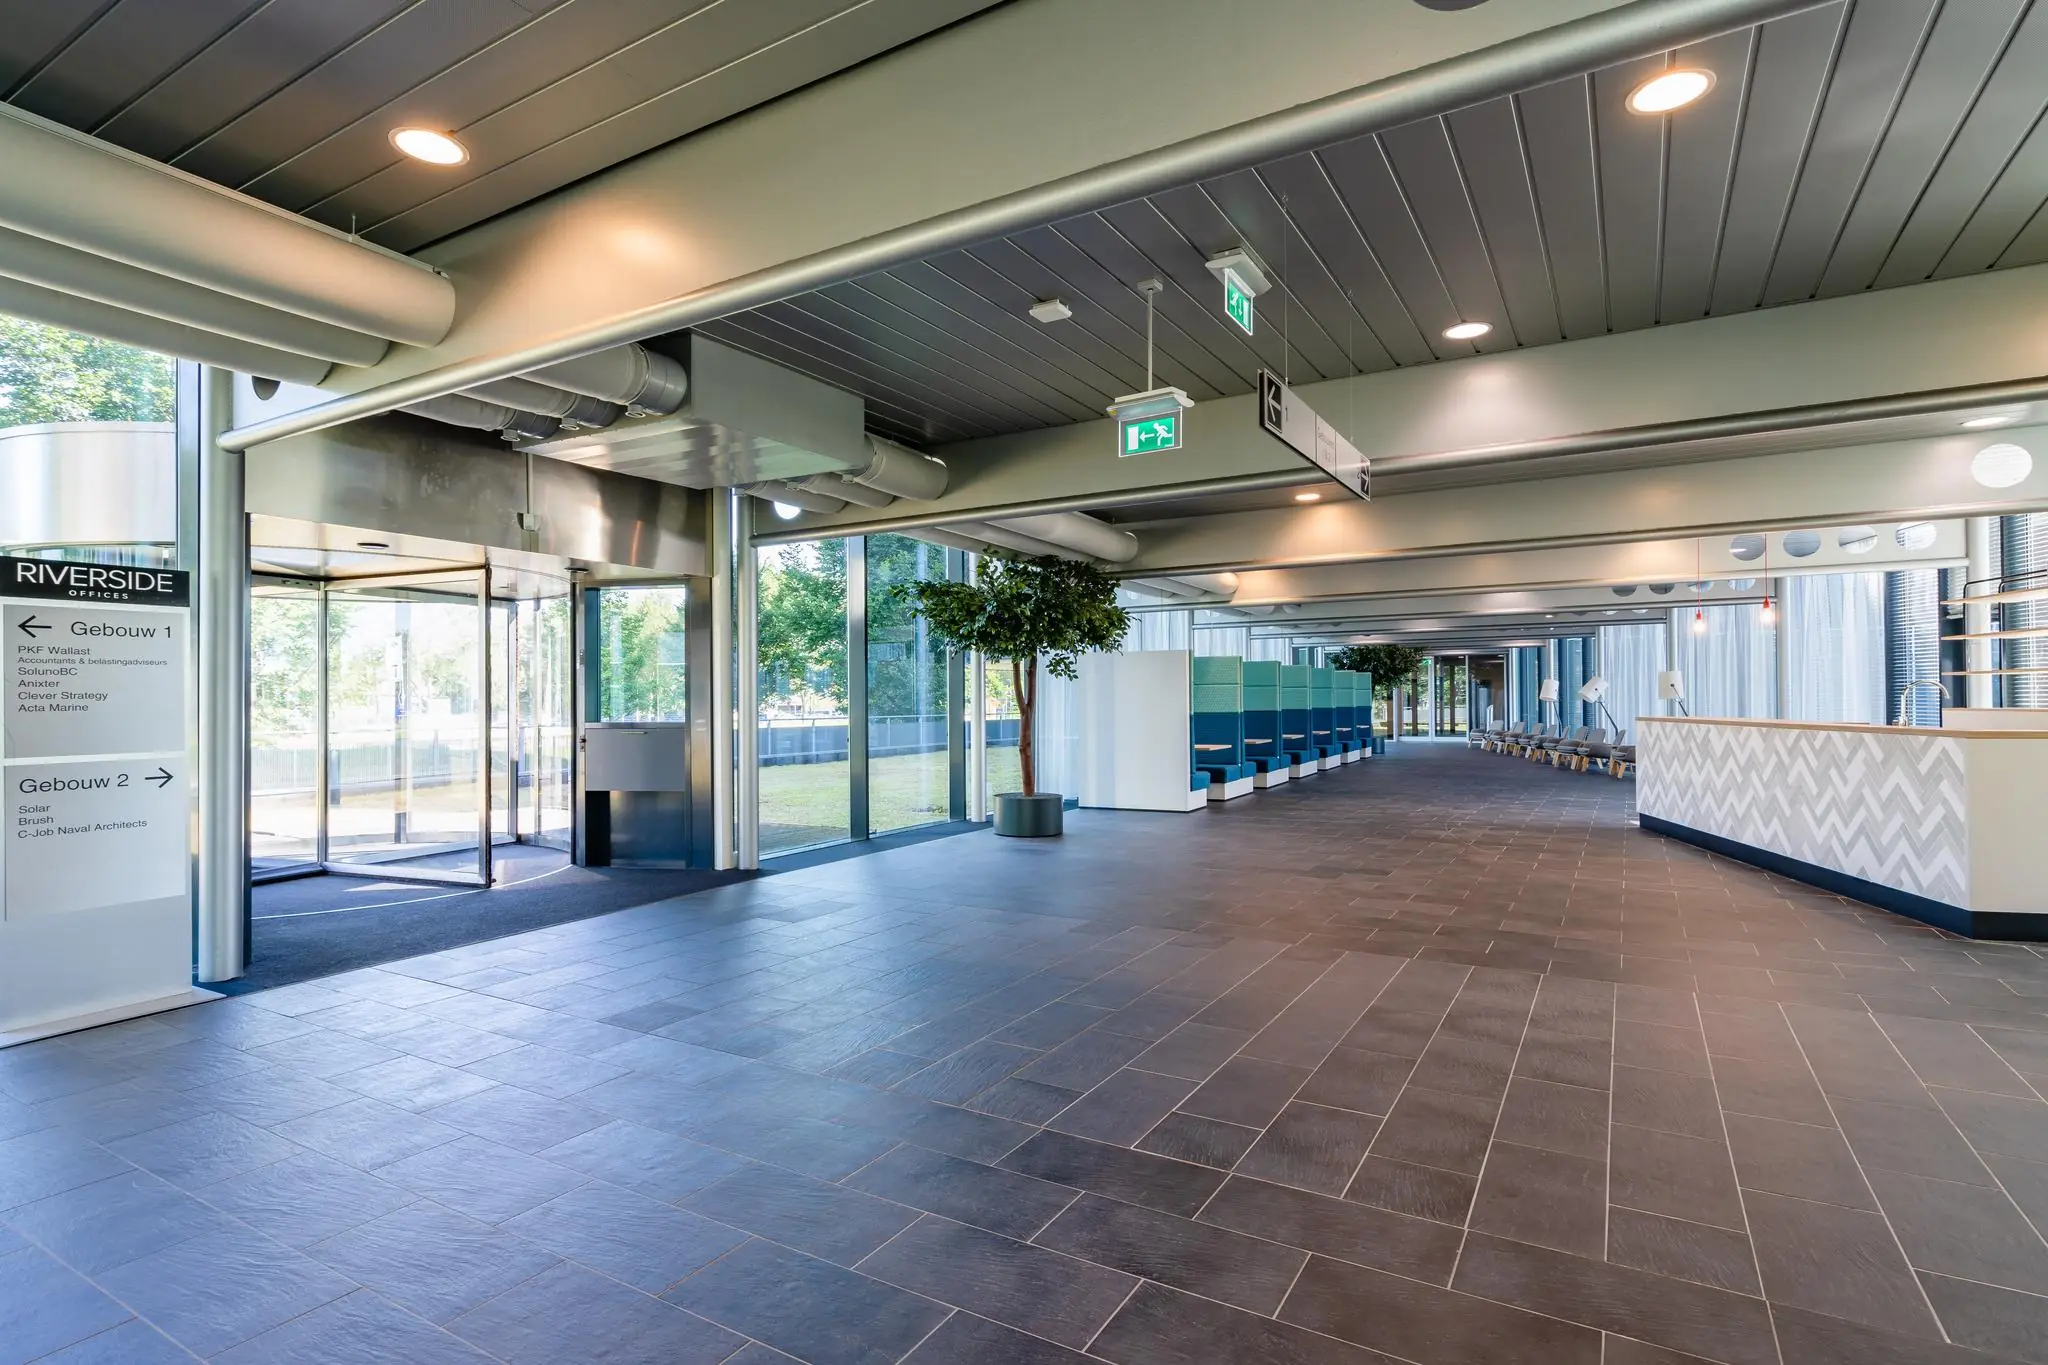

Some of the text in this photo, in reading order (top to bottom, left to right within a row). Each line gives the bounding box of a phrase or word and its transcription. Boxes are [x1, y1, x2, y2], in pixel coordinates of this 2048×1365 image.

[16, 562, 174, 593] RIVERSIDE
[68, 589, 129, 600] OFFICES
[70, 620, 172, 639] Gebouw 1
[17, 645, 91, 656] PKF Wallast
[17, 656, 168, 667] Accountants & belastingadviseurs
[17, 666, 78, 676] SolunoBC
[17, 679, 60, 688] Anixter
[17, 691, 109, 702] Clever Strategy
[18, 703, 89, 713] Acta Marine
[19, 773, 129, 794] Gebouw 2
[18, 804, 51, 815] Solar
[18, 816, 54, 827] Brush
[17, 819, 149, 839] C-Job Naval Architects
